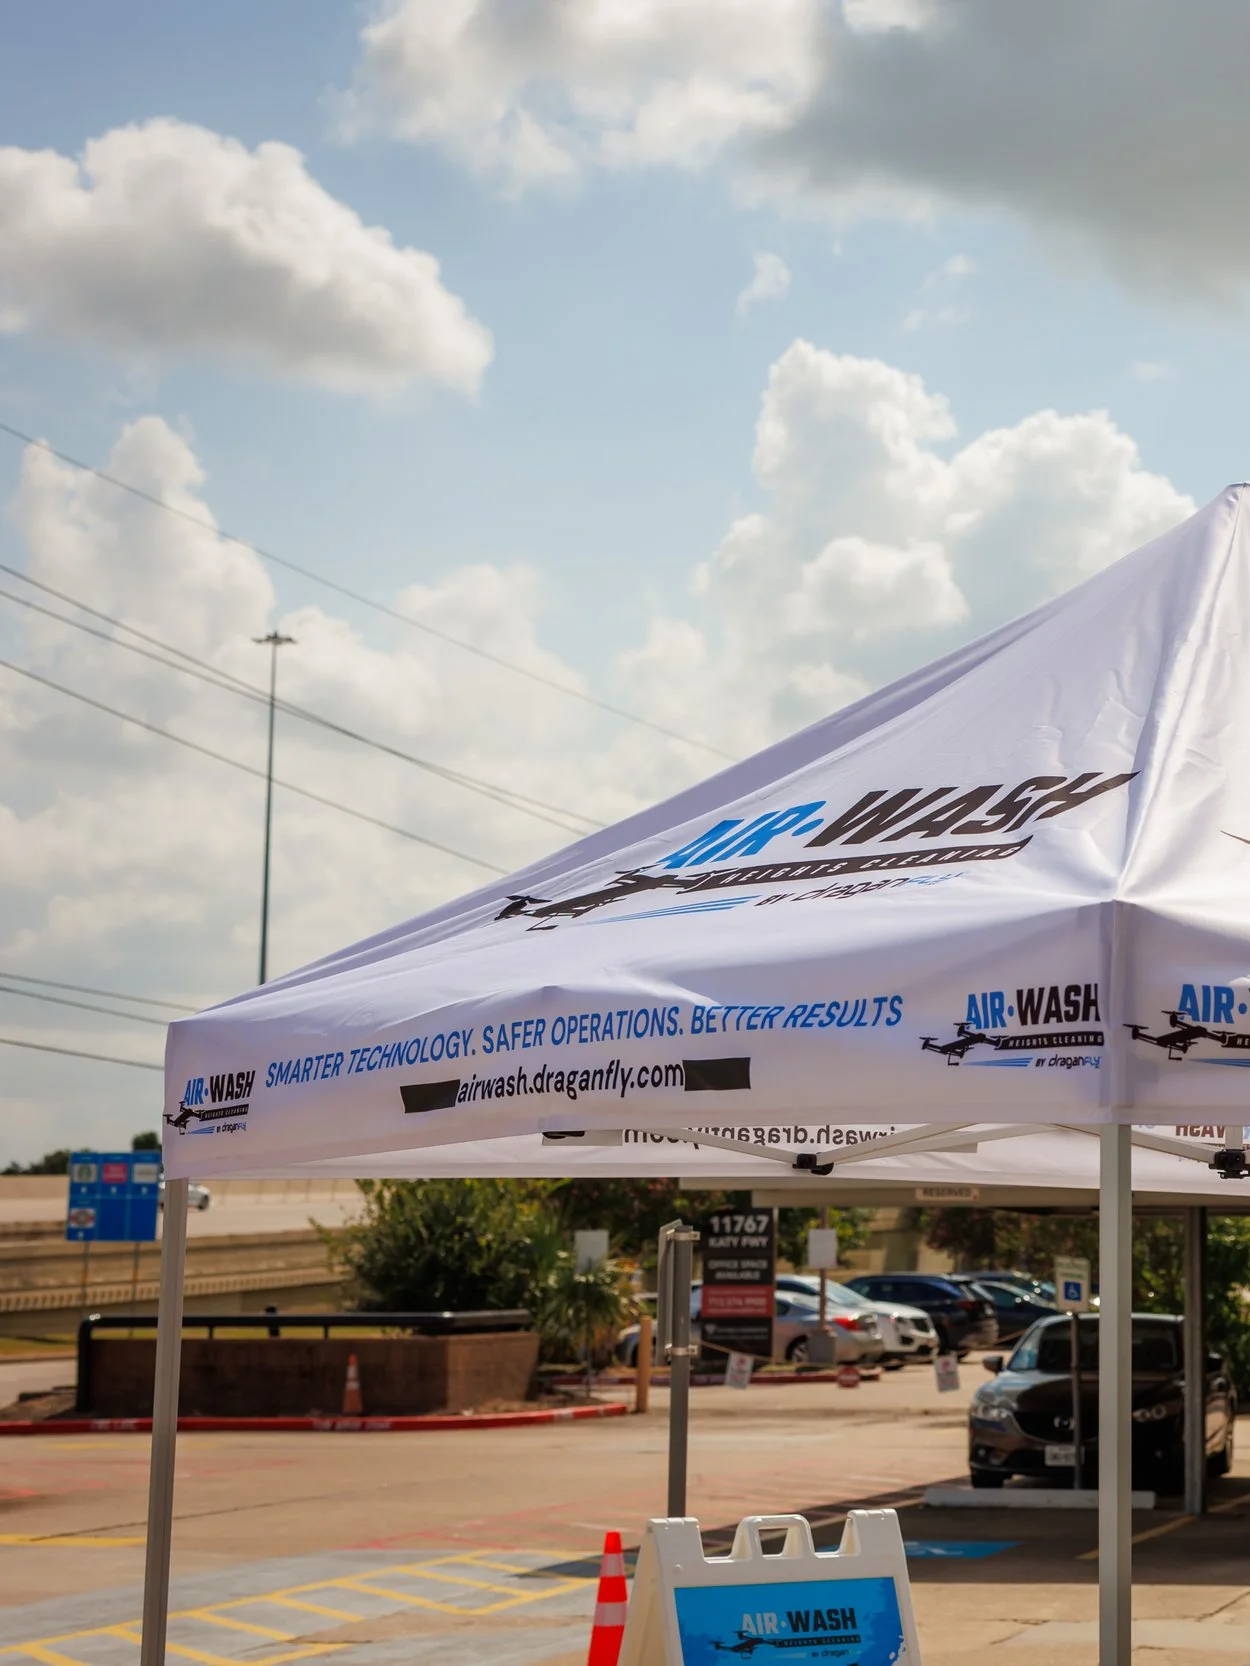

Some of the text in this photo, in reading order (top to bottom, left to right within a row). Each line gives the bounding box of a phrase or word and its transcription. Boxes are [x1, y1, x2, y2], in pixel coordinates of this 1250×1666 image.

[719, 846, 1021, 885] HEIGHTS CLEANING
[754, 892, 796, 907] BY
[265, 995, 904, 1089] SMARTER TECHNOLOGY. SAFER OPERATIONS. BETTER RESULTS
[1008, 1037, 1049, 1048] HEIGHTS
[457, 1059, 685, 1105] airwash.draganfly.com
[709, 1214, 770, 1234] 11767
[708, 1236, 769, 1248] KATY FWY
